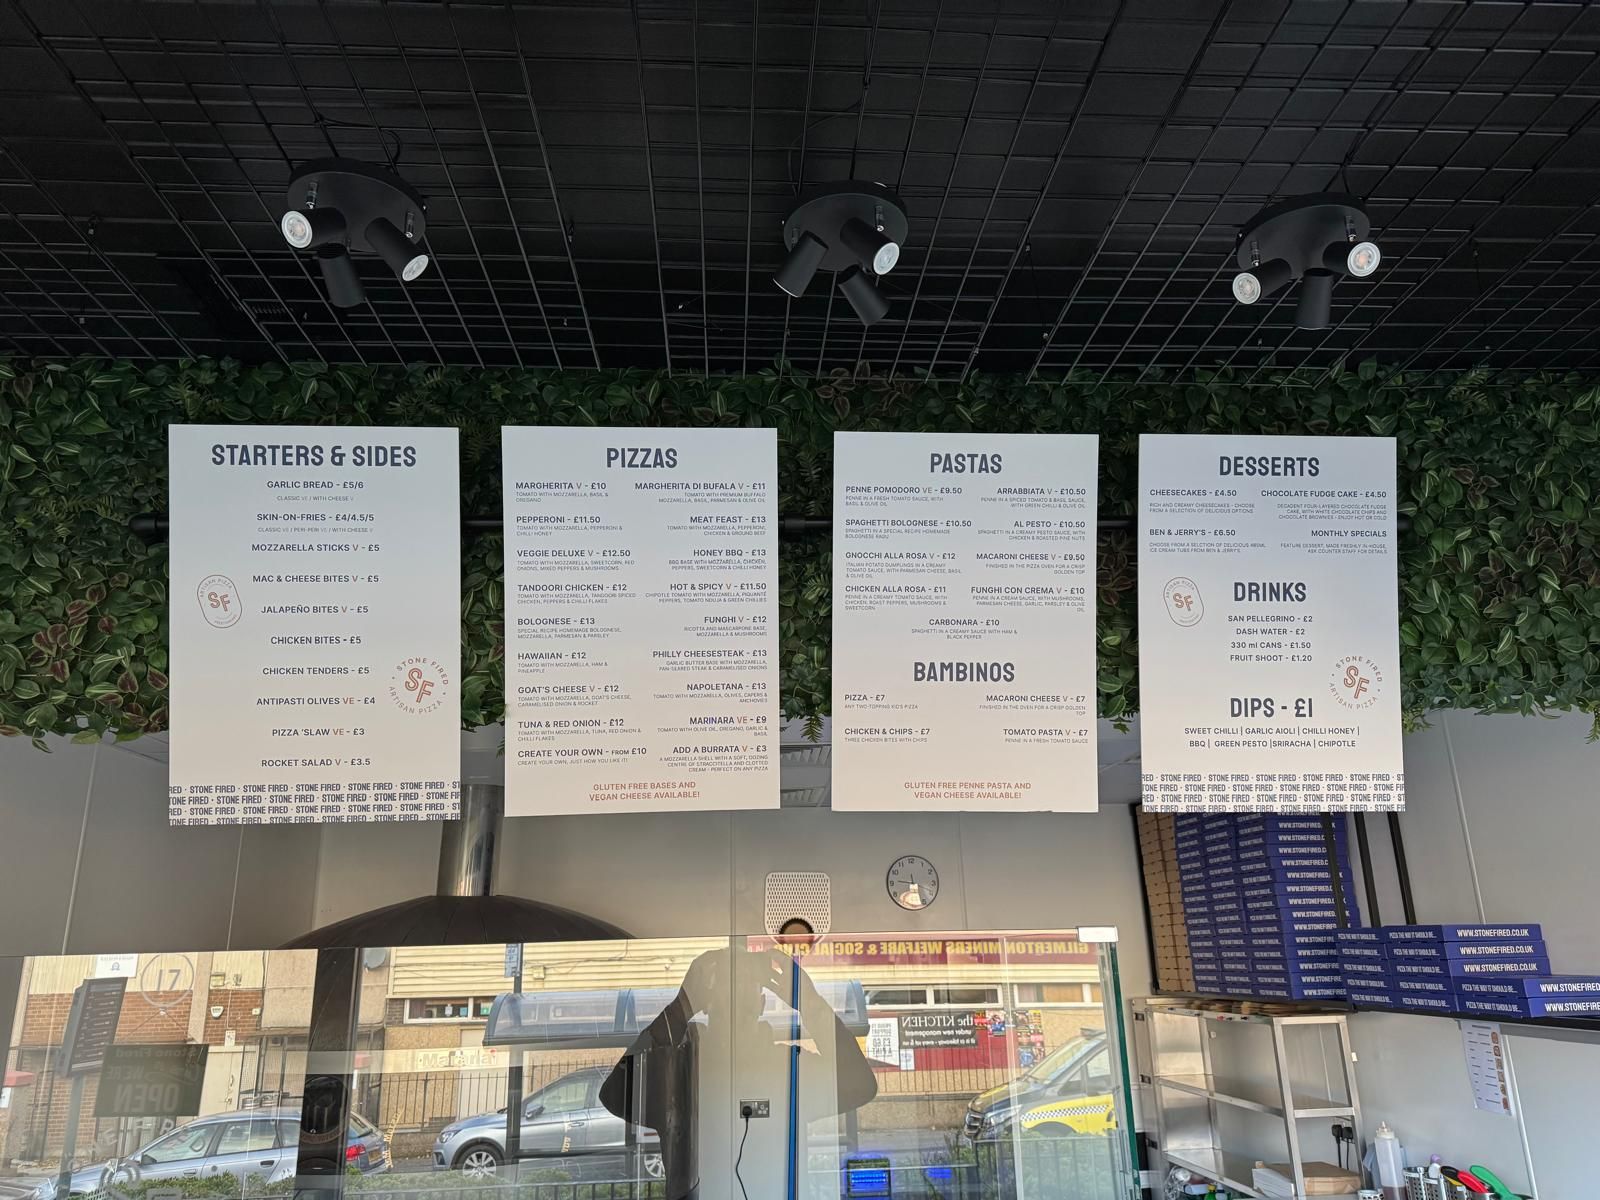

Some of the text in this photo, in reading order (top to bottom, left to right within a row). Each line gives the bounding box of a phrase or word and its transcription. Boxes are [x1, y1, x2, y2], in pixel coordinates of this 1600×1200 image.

[212, 444, 416, 467] STARTERS & SIDES
[606, 447, 677, 468] PIZZAS
[930, 453, 1001, 473] PASTAS
[1219, 455, 1319, 476] DESSERTS
[266, 480, 300, 488] GARLIC
[342, 481, 363, 489] £5/6
[1149, 488, 1206, 496] CHEESECAKES
[335, 513, 374, 521] £4/4.5/5
[1234, 581, 1306, 602] DRINKS
[261, 605, 310, 613] JALAPEÑO
[517, 617, 570, 625] BOLOGNESE
[683, 649, 744, 657] CHEESESTEAK
[358, 666, 369, 674] £5
[397, 658, 448, 684] STONE FIRED
[914, 661, 1014, 682] BAMBINOS
[405, 668, 434, 703] SF
[686, 682, 743, 690] NAPOLETANA
[1344, 666, 1369, 699] SF
[256, 697, 304, 705] ANTIPASTI
[389, 686, 442, 713] ARTISAN PIZZA
[1230, 697, 1274, 717] DIPS
[689, 716, 734, 724] MARINARA
[756, 715, 766, 723] £9
[272, 728, 298, 736] PIZZA
[589, 793, 617, 801] VEGAN
[653, 790, 699, 798] AVAILABLE!
[1457, 929, 1529, 937] WWW.STONEFIRED.CO.UK
[1460, 946, 1534, 954] WWW.STONEFIRED.CO.UK
[1464, 963, 1538, 972] WWW.STONEFIRED.CO.UK
